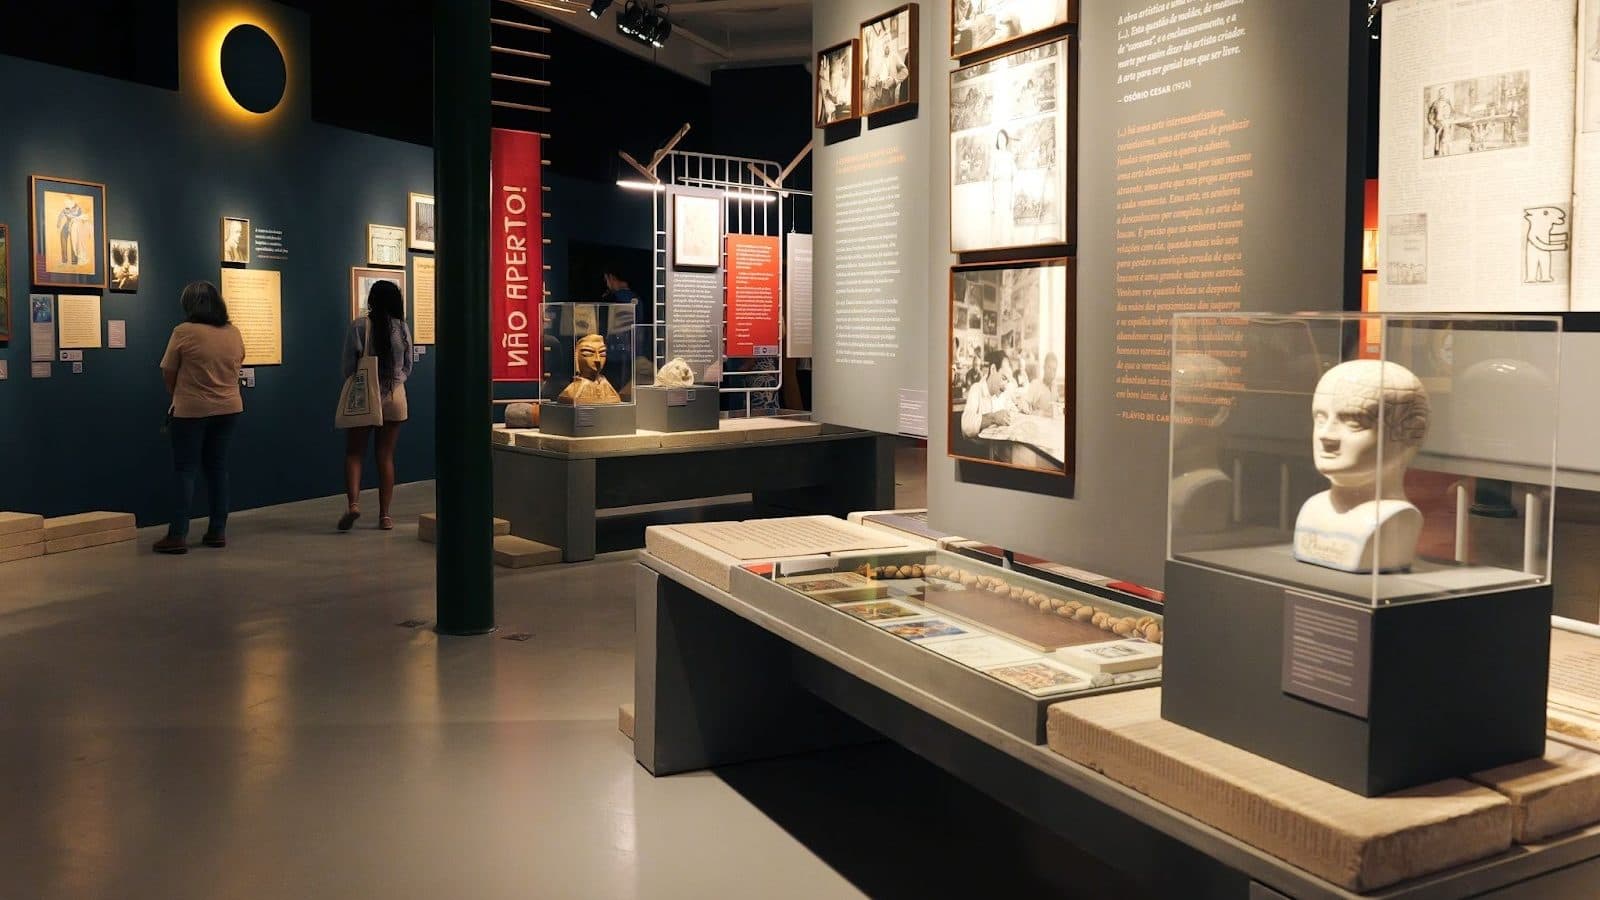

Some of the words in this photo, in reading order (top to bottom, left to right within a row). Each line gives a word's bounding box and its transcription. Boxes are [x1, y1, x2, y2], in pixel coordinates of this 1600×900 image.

[1123, 90, 1148, 102] OSÓRIO
[1149, 86, 1170, 96] CESAR
[503, 185, 529, 300] APERTO!
[502, 311, 529, 367] NÃO
[1121, 409, 1145, 419] FLÁVIO
